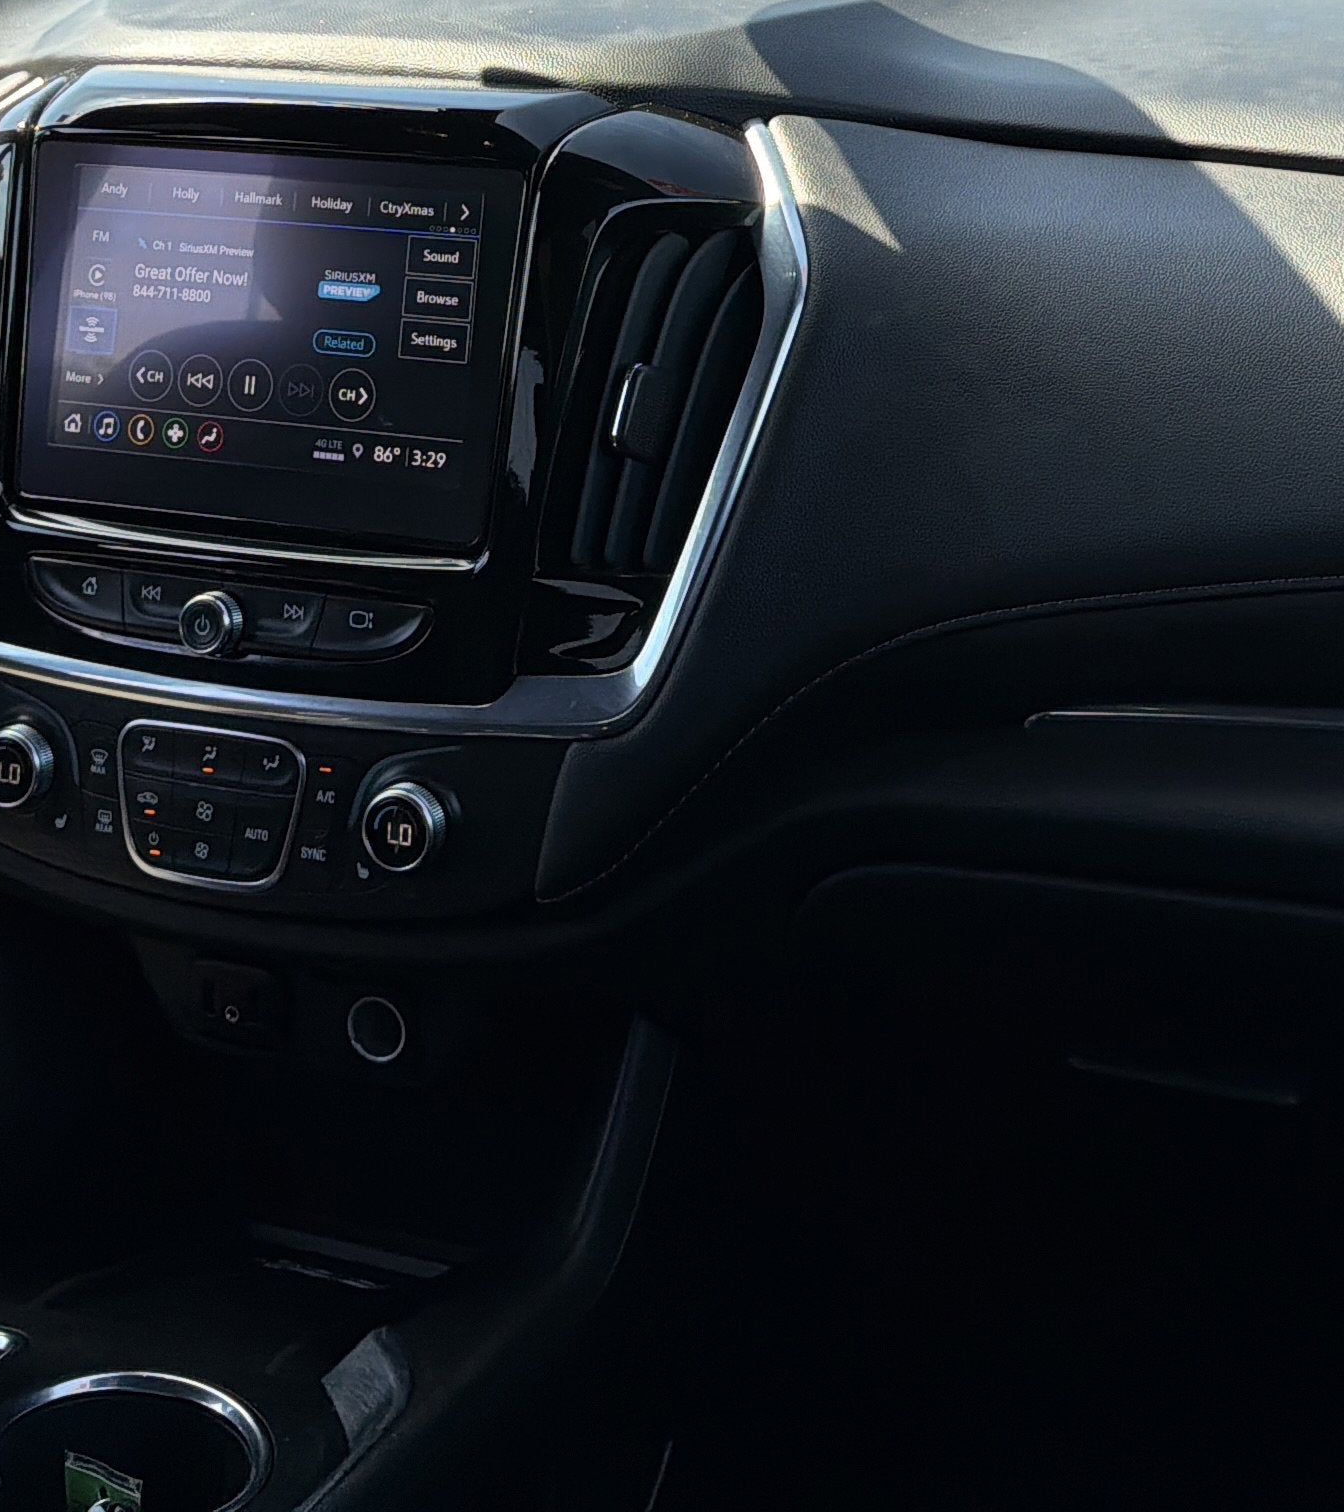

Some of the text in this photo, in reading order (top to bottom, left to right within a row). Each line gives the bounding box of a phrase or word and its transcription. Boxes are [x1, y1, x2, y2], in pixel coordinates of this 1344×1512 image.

[101, 182, 129, 199] Andy
[172, 186, 201, 204] Holly
[234, 191, 283, 207] Hallmark
[311, 195, 354, 213] Holiday
[379, 200, 435, 218] CtryXmas
[92, 230, 110, 242] FM
[152, 240, 166, 251] Ch
[179, 242, 218, 256] SiriusXM
[220, 244, 255, 258] Preview
[423, 249, 459, 265] Sound
[135, 264, 249, 287] Great Offer Now!
[324, 269, 376, 284] SIRIUSXM
[73, 289, 99, 300] iPhone
[132, 284, 211, 304] 844-711-8800
[416, 291, 460, 307] Browse
[324, 335, 364, 351] Related
[410, 331, 458, 351] Settings
[65, 371, 92, 384] More
[146, 370, 164, 383] CH
[338, 388, 356, 402] CH
[315, 438, 343, 449] 4G LTE
[373, 445, 401, 463] 86°
[411, 449, 447, 469] 3:29
[315, 789, 336, 805] A/C
[244, 827, 269, 843] AUTO
[386, 821, 412, 846] LO
[300, 846, 327, 863] SYNC
